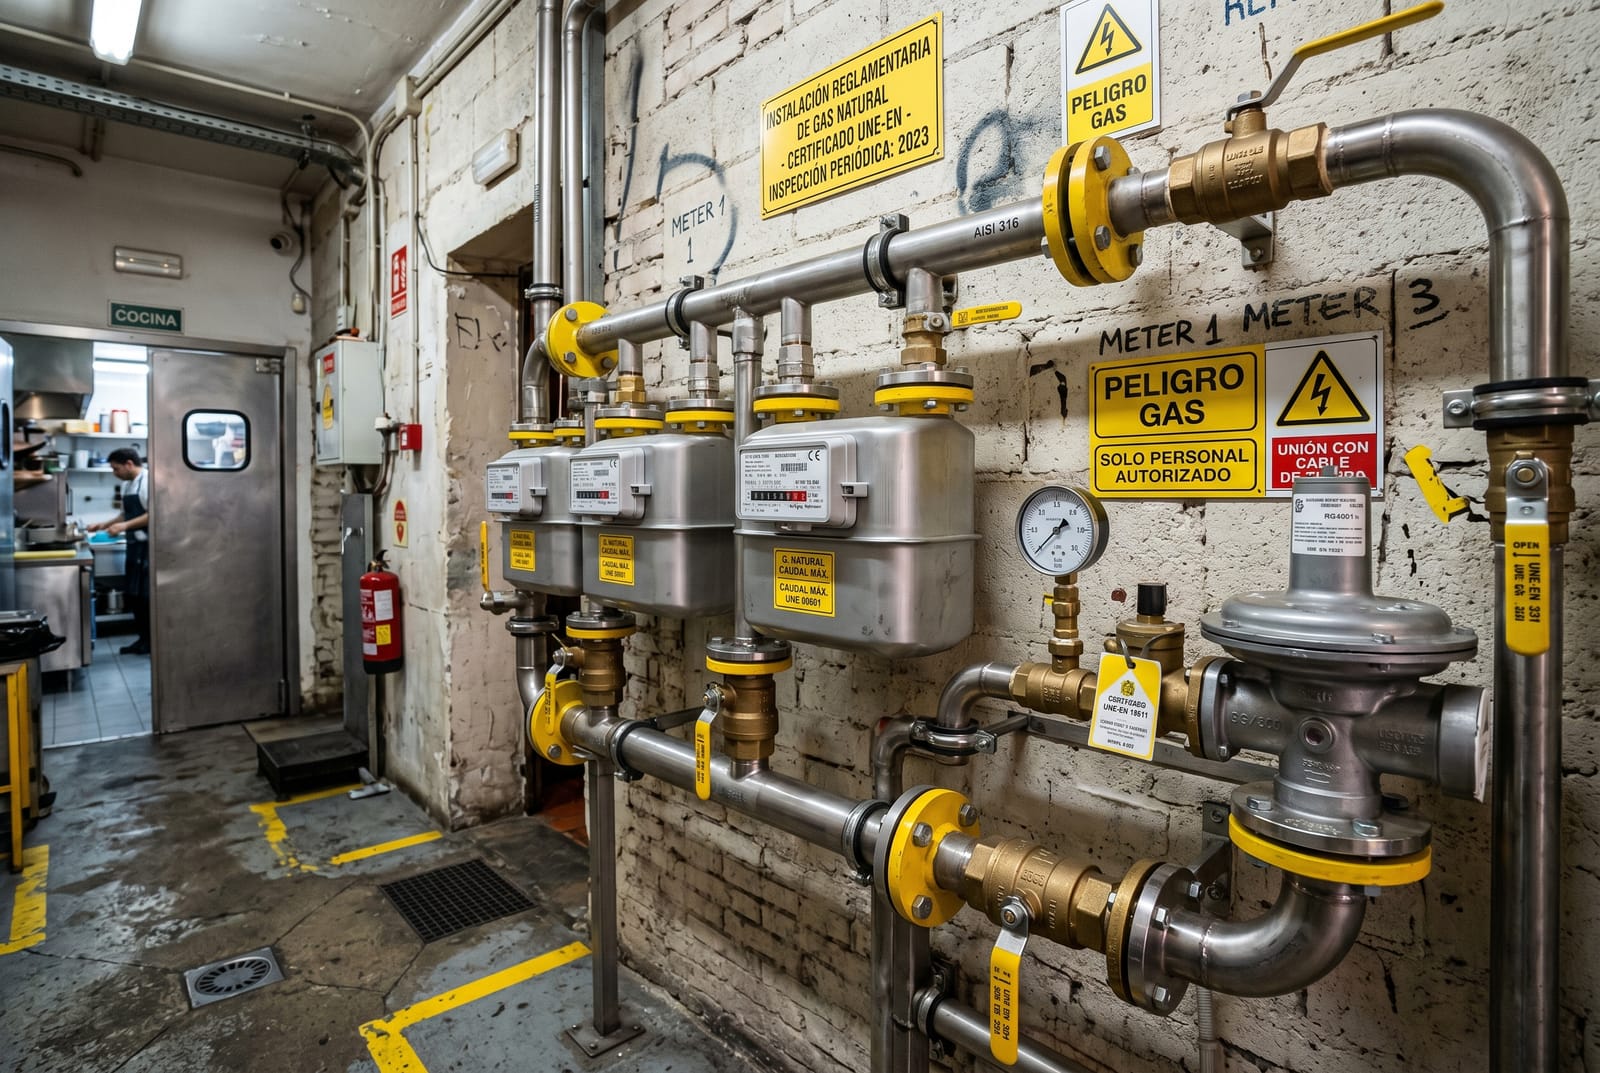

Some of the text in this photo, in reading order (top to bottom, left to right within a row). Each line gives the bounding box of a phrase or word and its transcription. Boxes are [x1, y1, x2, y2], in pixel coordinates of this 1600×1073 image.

[766, 36, 931, 130] INSTALACIÓN REGLAMENTARIA
[1072, 74, 1147, 115] PELIGRO
[797, 85, 889, 140] DE GAS NATURAL
[1091, 103, 1127, 130] GAS
[787, 126, 854, 170] CERTIFICADO
[857, 106, 902, 141] UNE-EN
[769, 125, 930, 202] INSPECCIÓN PERIÓDICA: 2023
[672, 194, 726, 237] METER 1
[973, 217, 1020, 240] AISI 316
[1242, 277, 1441, 332] METER 3
[115, 309, 177, 326] COCINA
[1099, 313, 1223, 356] METER 1
[1104, 364, 1245, 400] PELIGRO
[1139, 399, 1206, 427] GAS
[1100, 448, 1250, 467] SOLO PERSONAL
[1277, 440, 1369, 456] UNIÓN CON
[1115, 468, 1232, 484] AUTORIZADO
[1513, 541, 1540, 549] OPEN
[779, 565, 808, 576] CAUDAL
[791, 556, 825, 566] NATURAL
[780, 582, 808, 594] CAUDAL
[785, 594, 800, 604] UNE
[1103, 703, 1128, 715] UNE-EN
